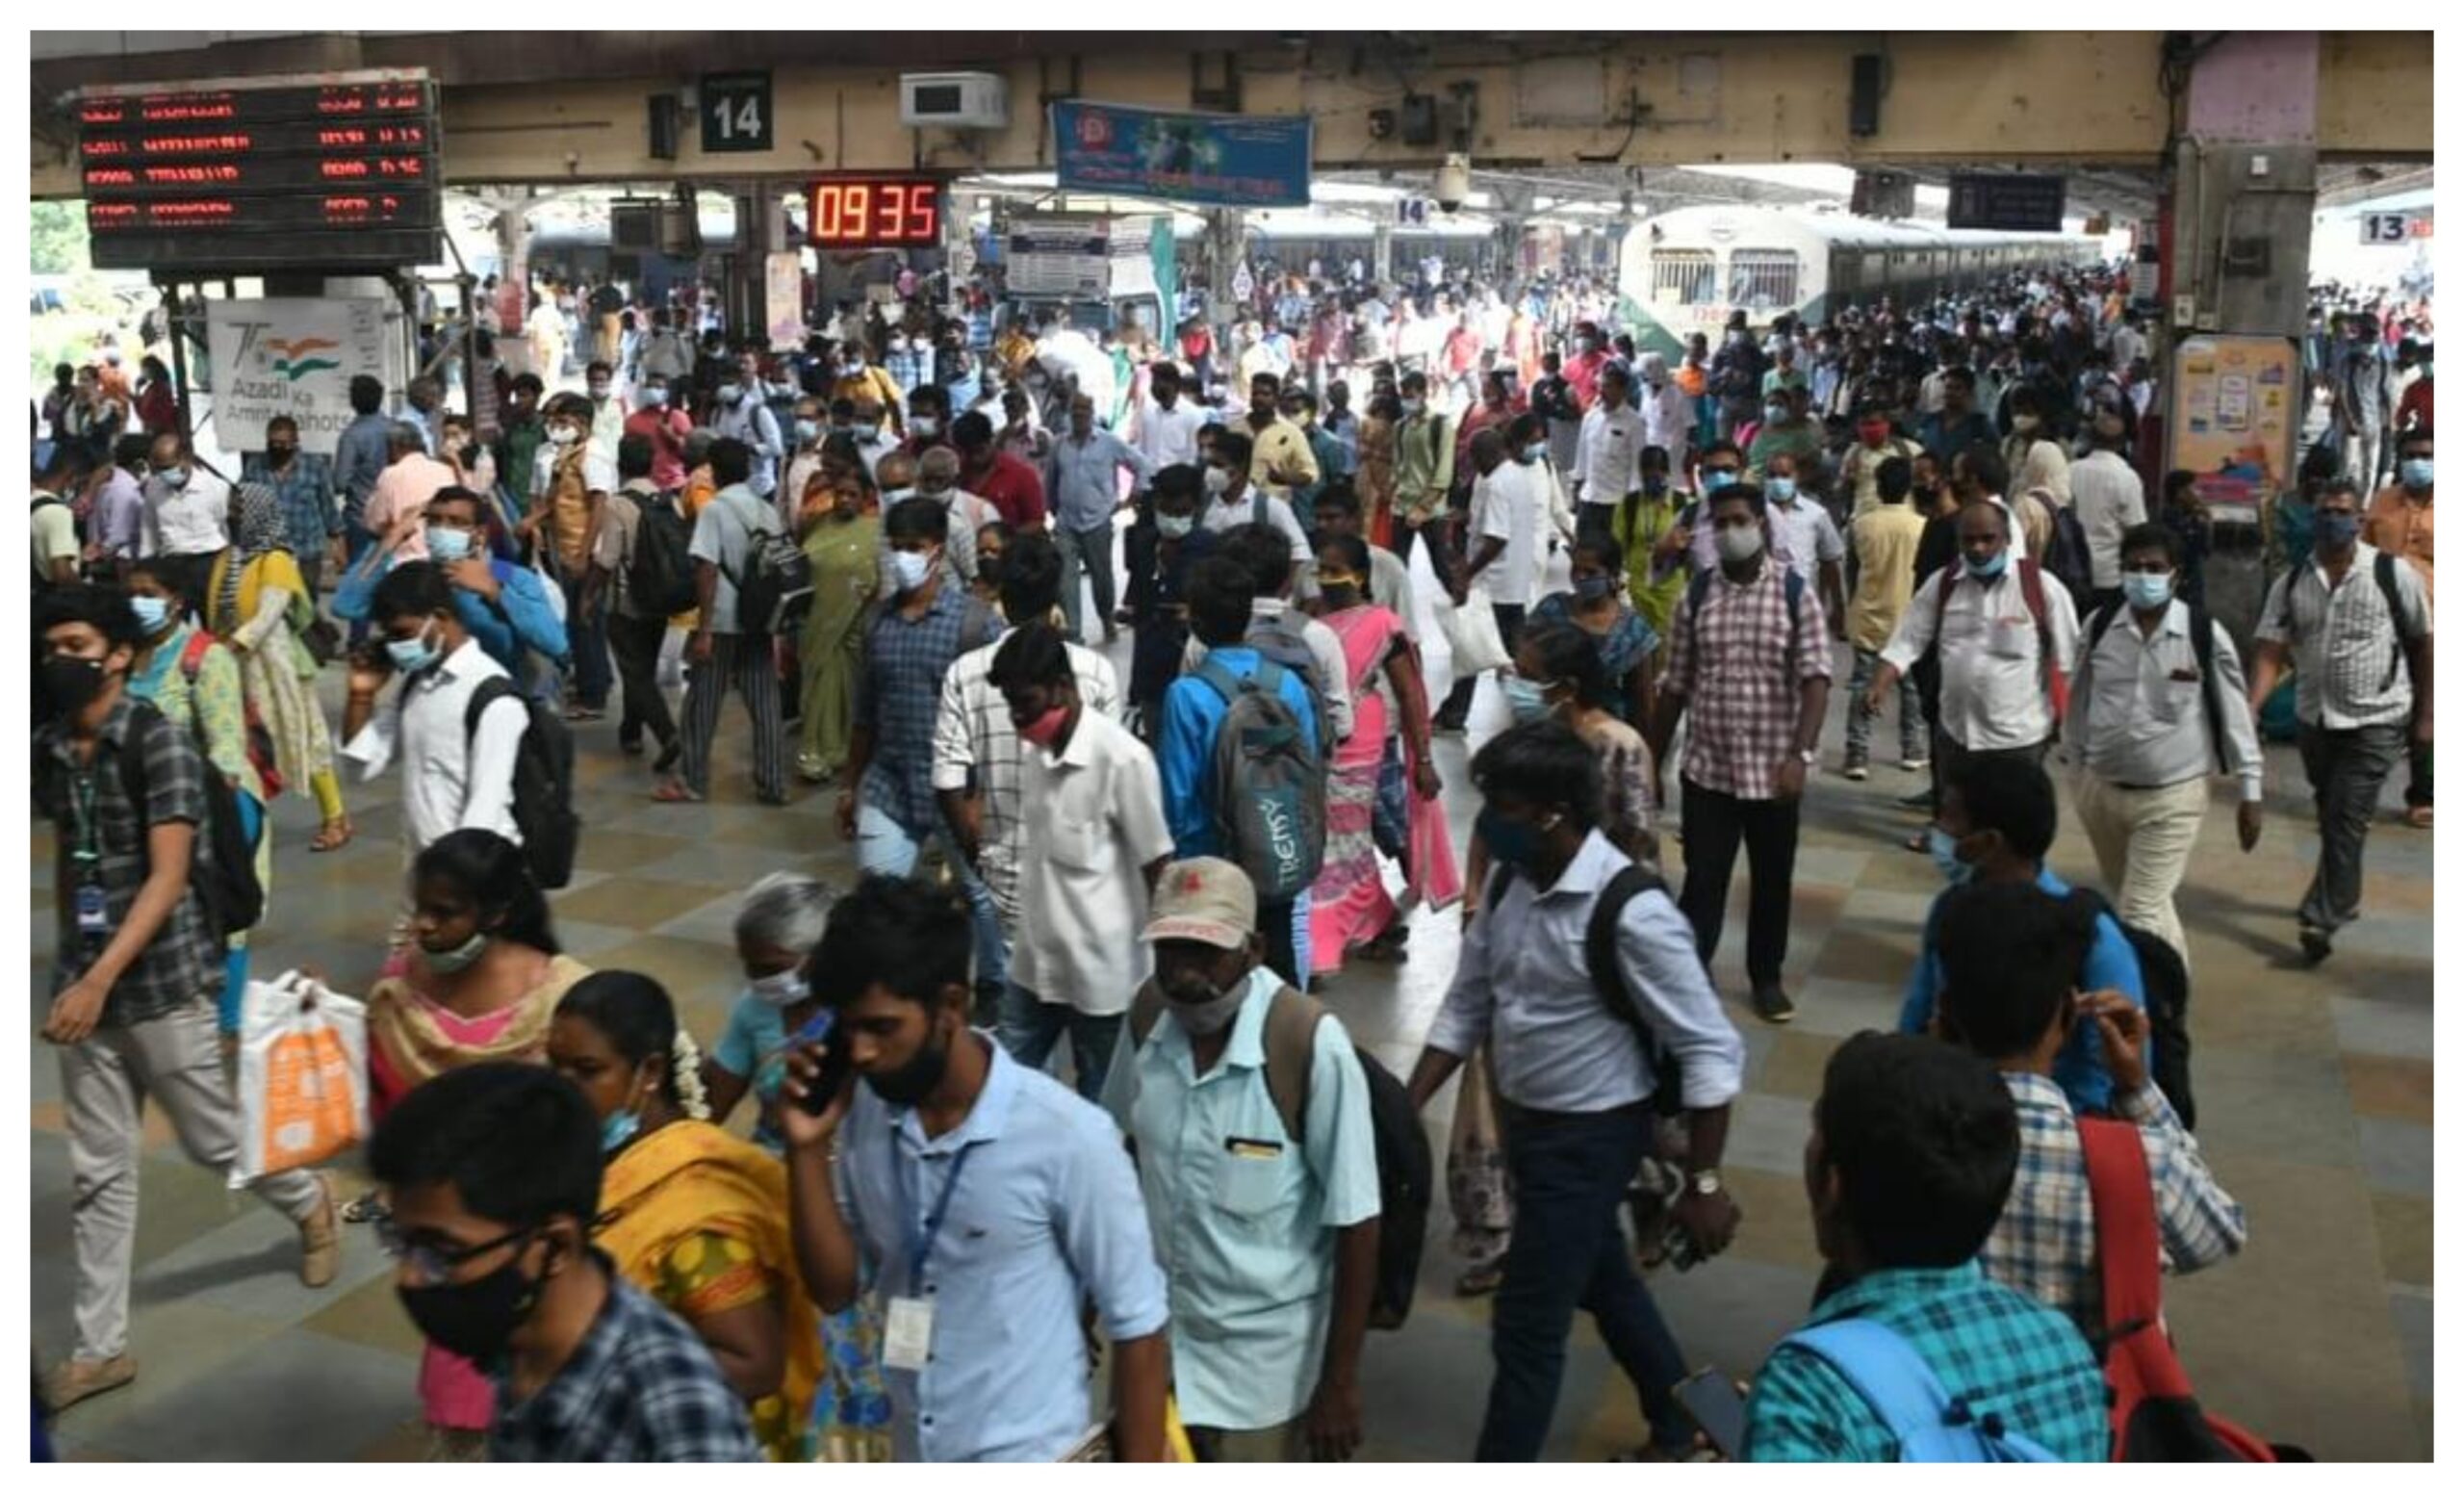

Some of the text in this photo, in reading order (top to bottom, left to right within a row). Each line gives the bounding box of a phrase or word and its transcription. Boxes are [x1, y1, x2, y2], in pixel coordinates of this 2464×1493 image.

[713, 96, 761, 139] 14
[1399, 198, 1424, 223] 14
[2368, 215, 2404, 241] 13
[231, 377, 289, 400] Azadi
